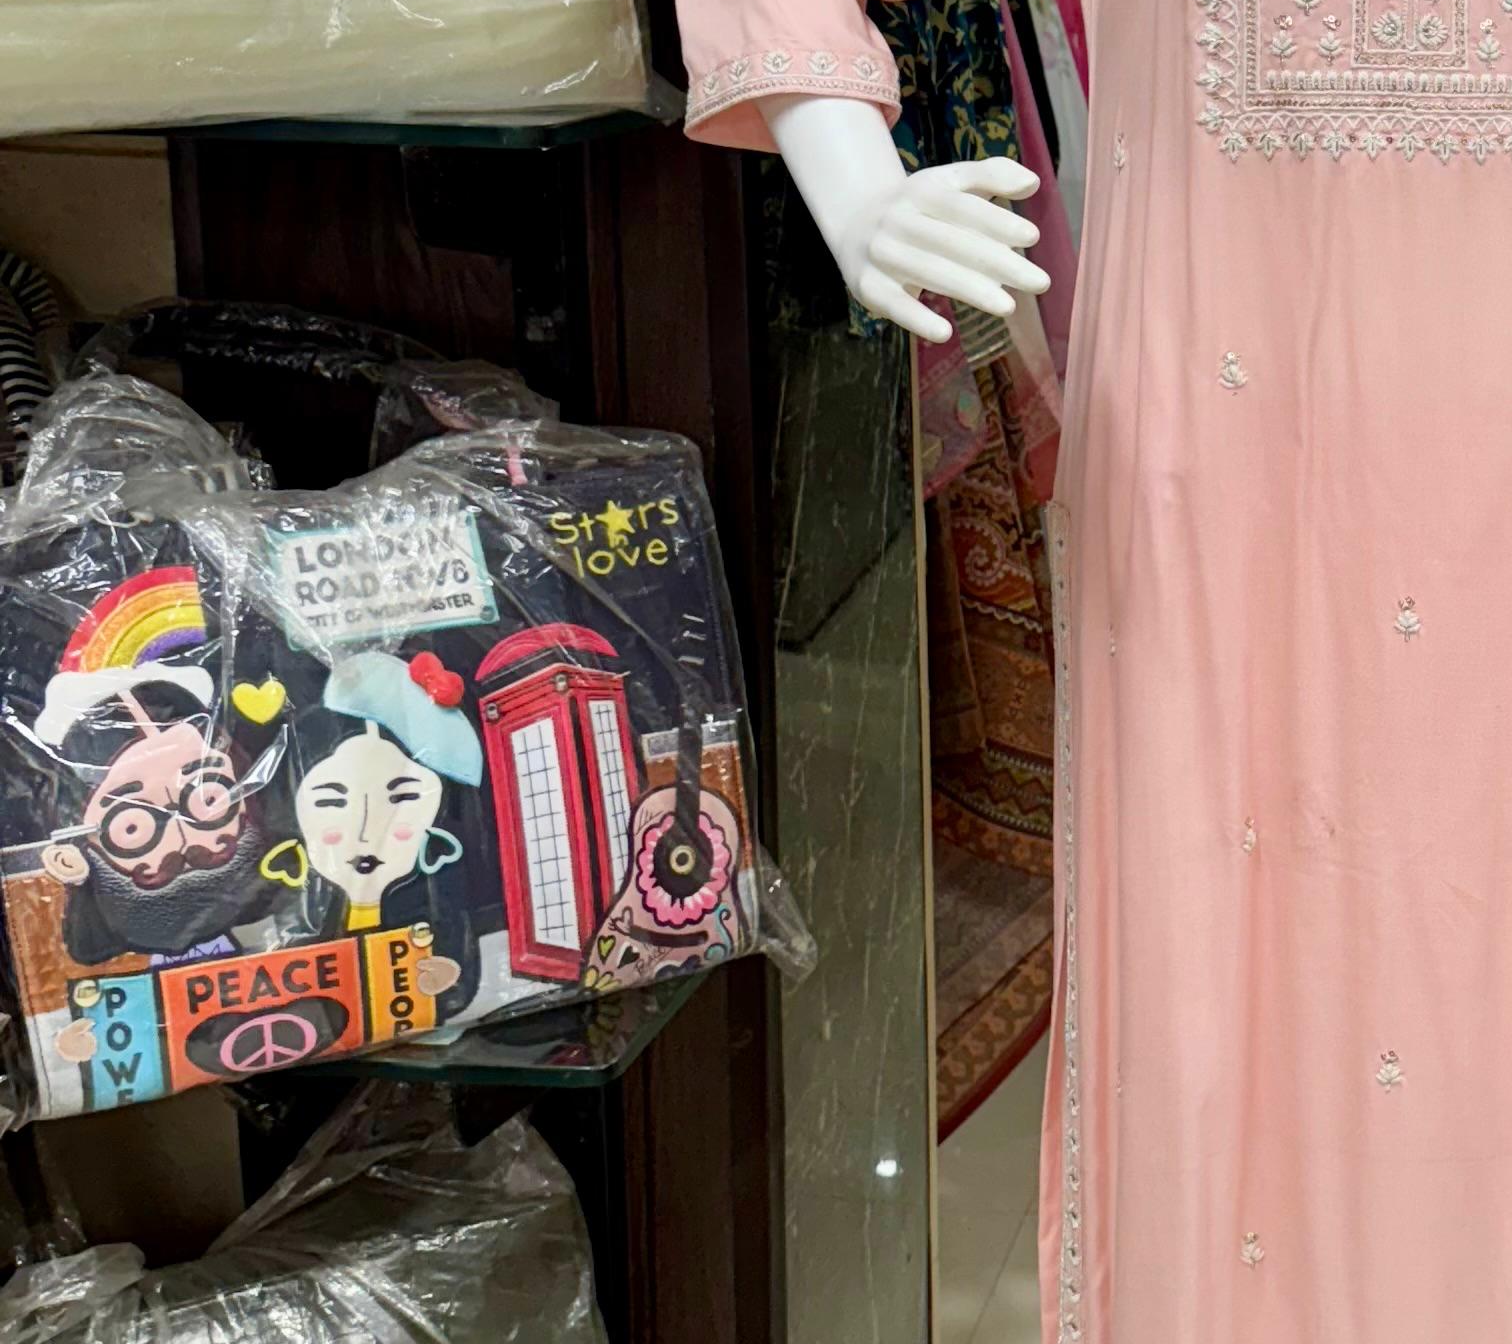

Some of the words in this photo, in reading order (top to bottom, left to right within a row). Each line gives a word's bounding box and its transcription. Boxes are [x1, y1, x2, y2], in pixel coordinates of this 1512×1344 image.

[573, 538, 669, 579] love
[295, 571, 380, 606] ROAD
[186, 954, 340, 1014] PEACE
